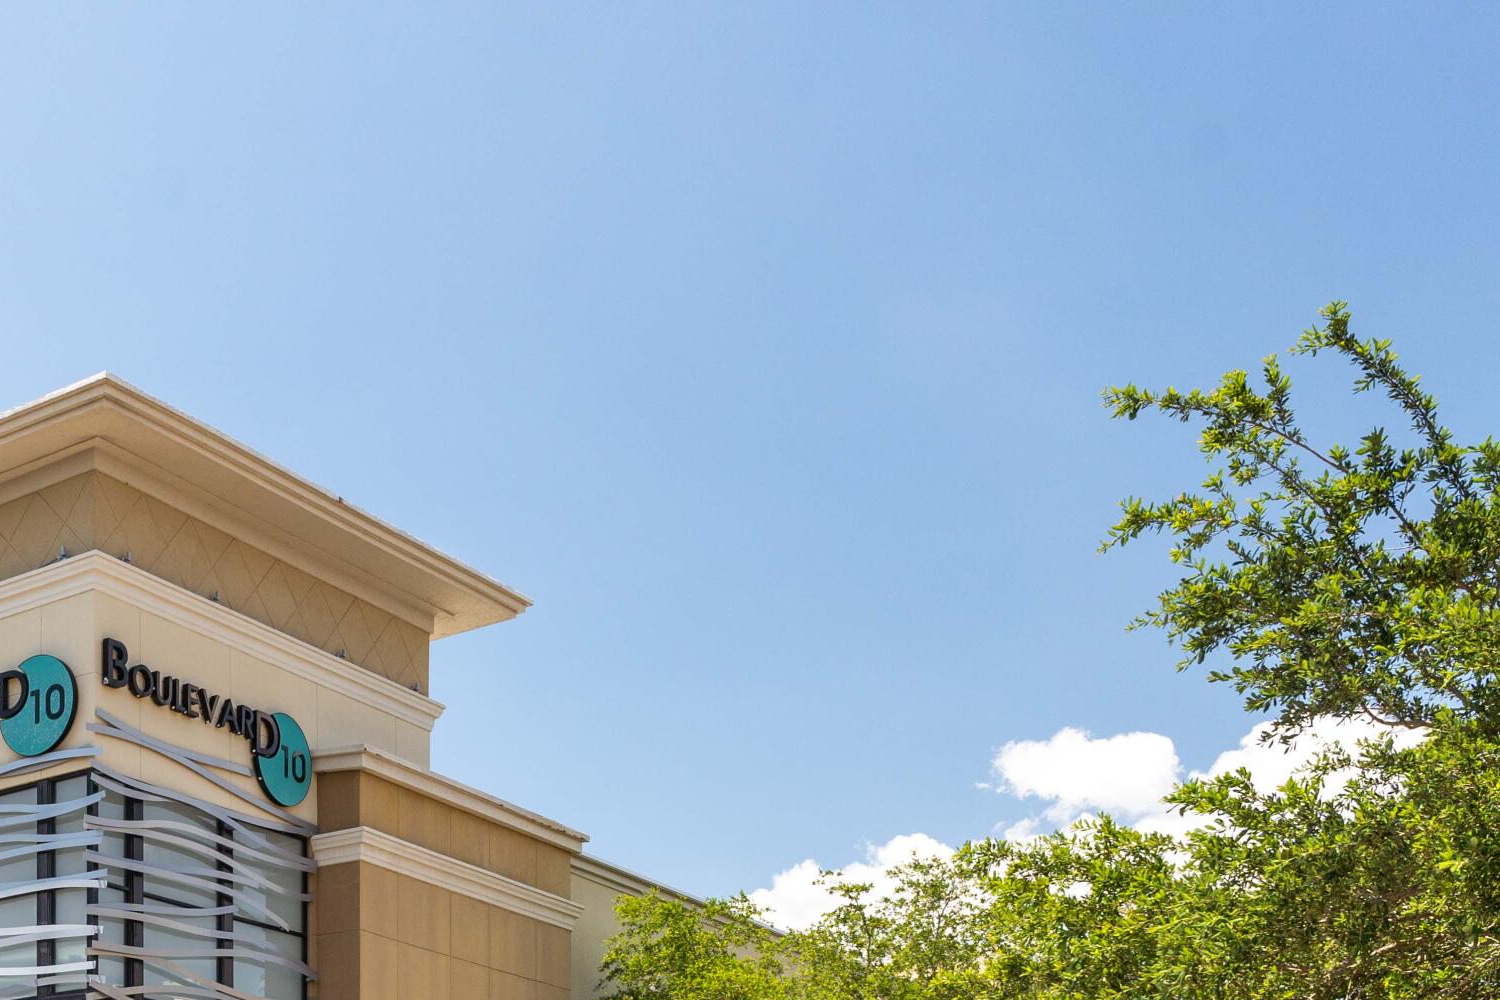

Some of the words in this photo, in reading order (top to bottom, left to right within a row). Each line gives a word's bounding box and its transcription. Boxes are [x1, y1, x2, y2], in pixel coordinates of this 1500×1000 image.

[30, 683, 65, 725] 10
[102, 637, 280, 758] BOULEVARD
[280, 745, 307, 783] 10
